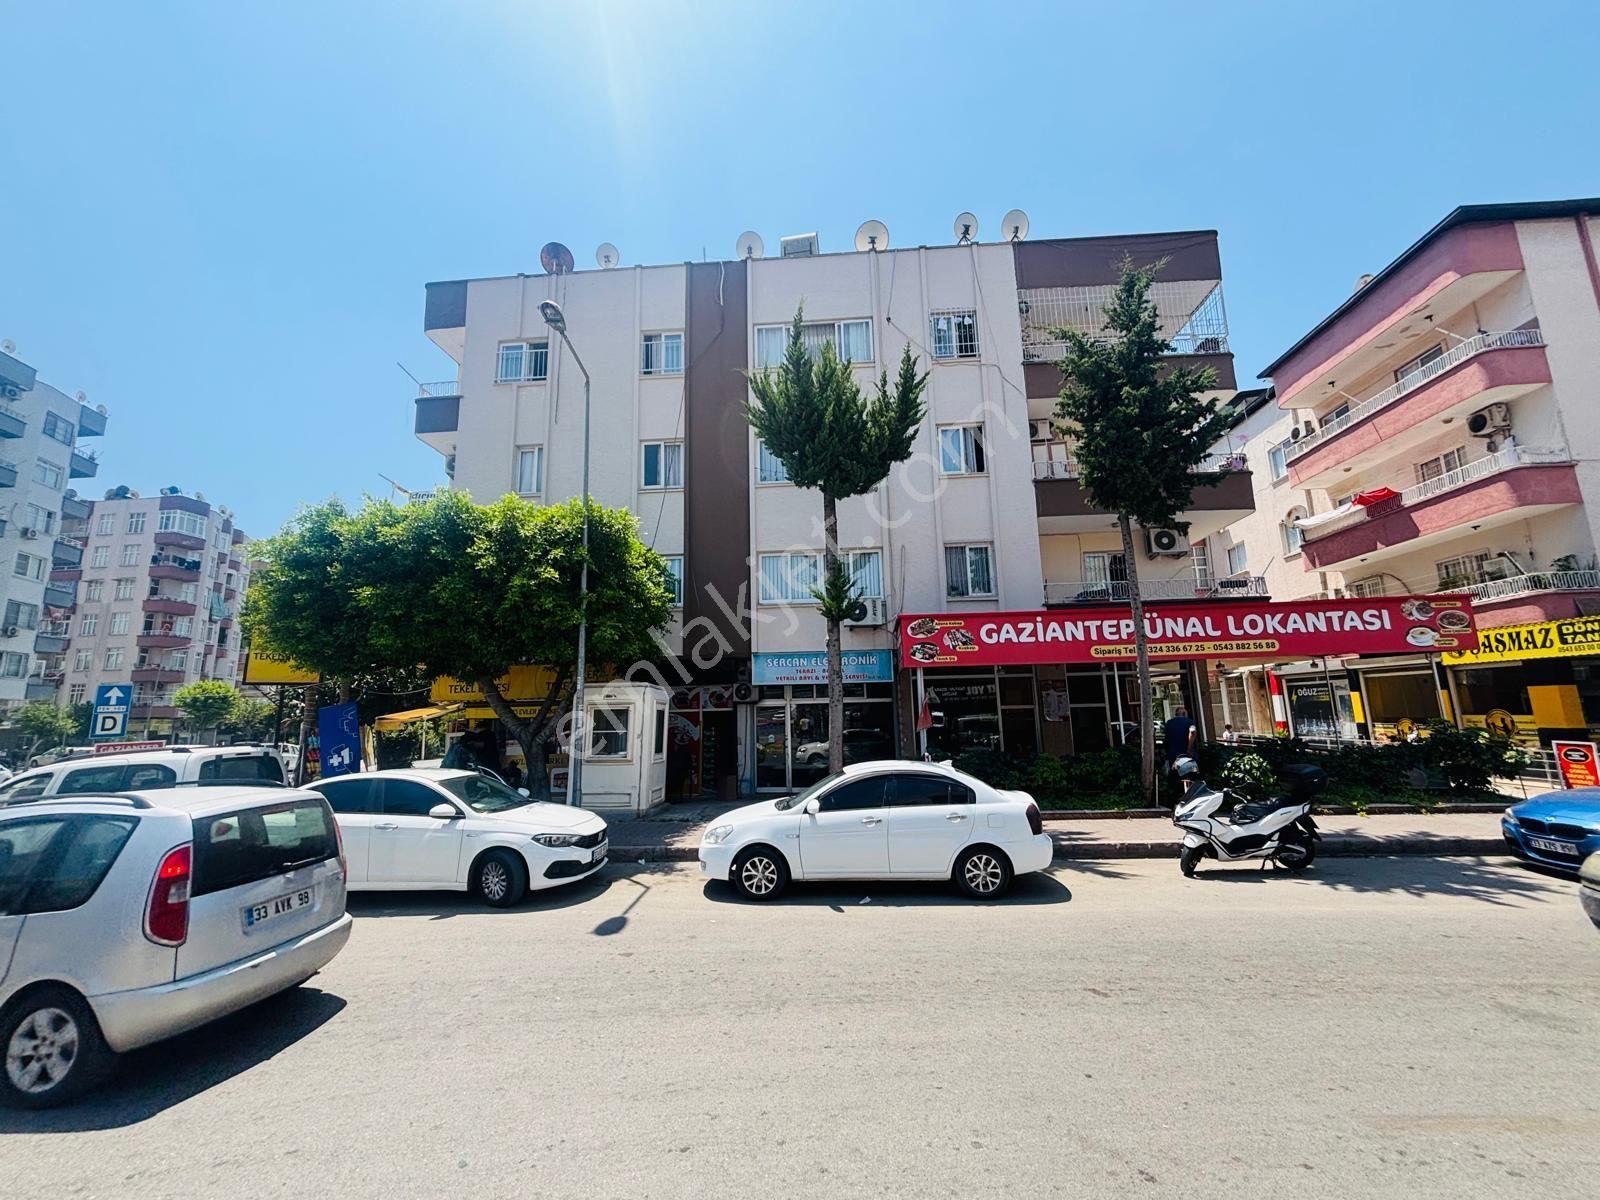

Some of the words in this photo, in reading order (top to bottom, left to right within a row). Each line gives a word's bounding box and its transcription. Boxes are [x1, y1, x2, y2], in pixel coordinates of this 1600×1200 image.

[980, 616, 1135, 644] GAZİANTEP
[1144, 612, 1221, 639] ÜNAL
[1227, 609, 1391, 635] LOKANTASI
[1094, 647, 1122, 656] Sipariş
[1165, 645, 1181, 653] 336
[1182, 644, 1193, 652] 67
[1194, 643, 1206, 652] 25
[1212, 642, 1234, 651] 0543
[1235, 641, 1251, 650] 882
[1253, 641, 1264, 650] 56
[767, 657, 808, 668] SERCAN
[811, 653, 877, 667] ELERONİK
[448, 684, 476, 694] TEKEL
[100, 715, 117, 732] D
[254, 905, 268, 921] 33
